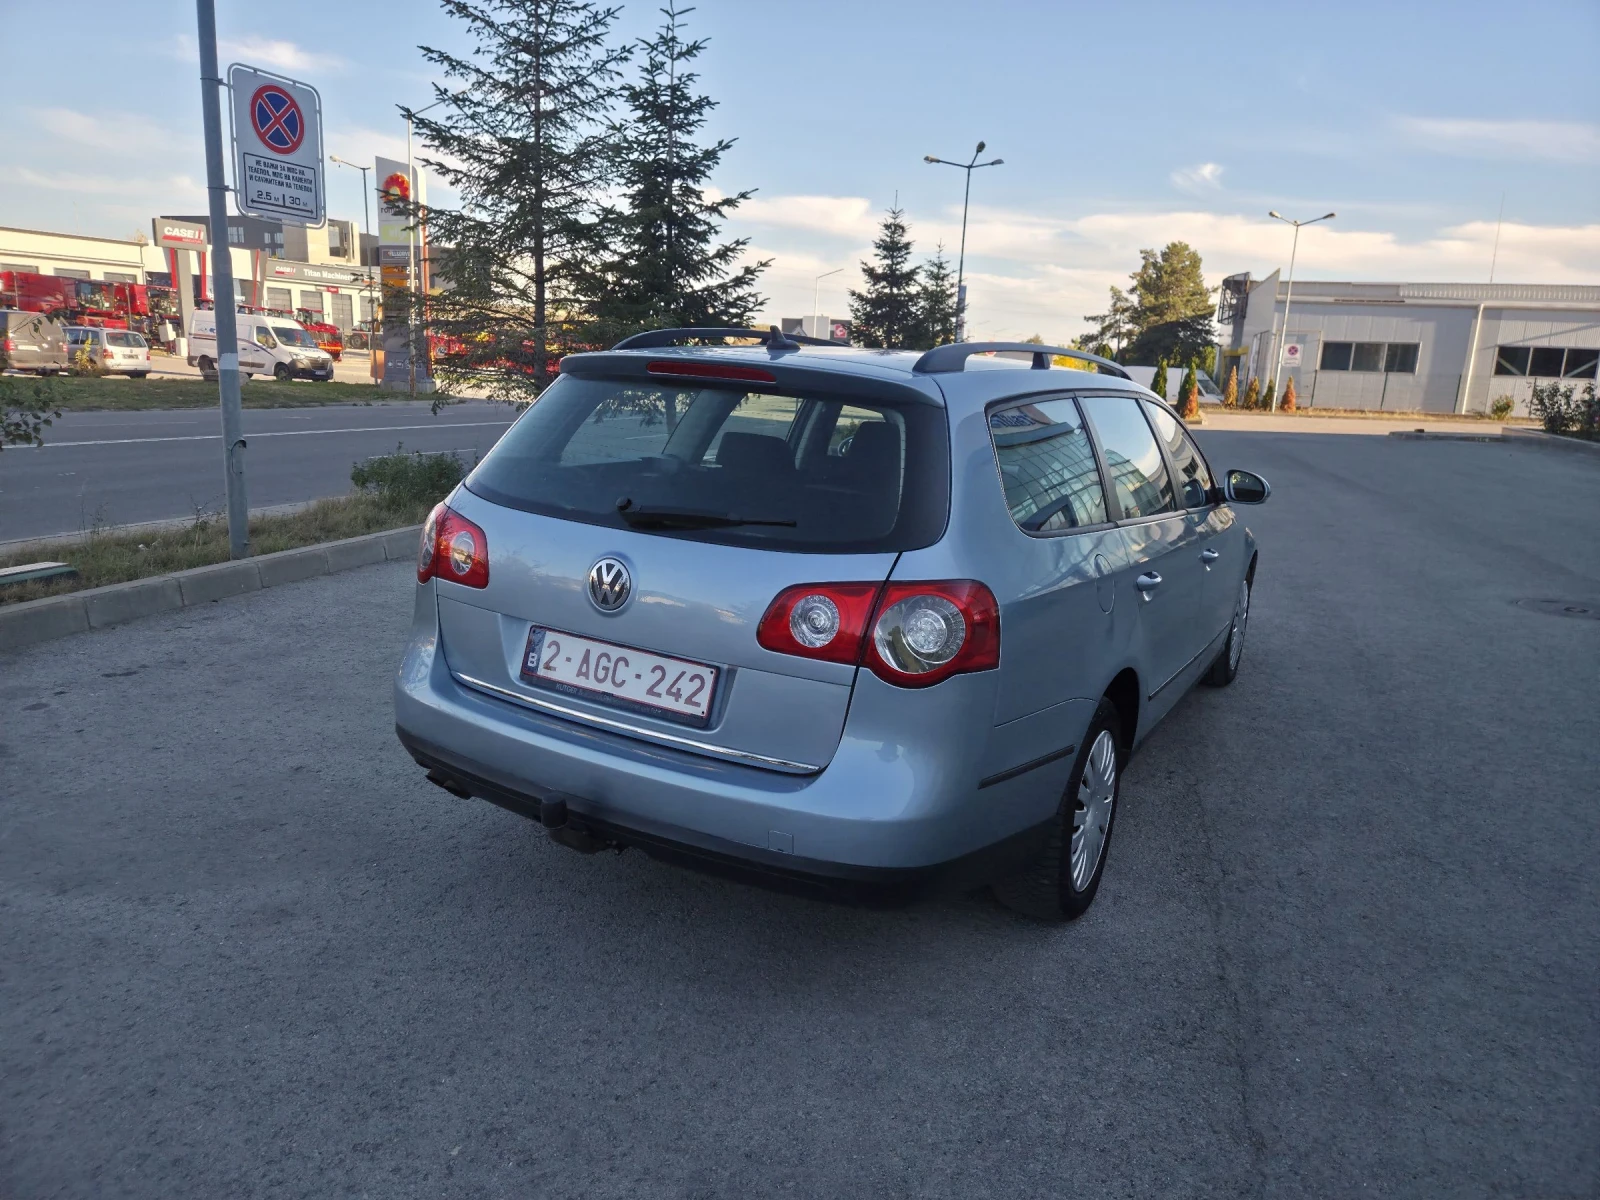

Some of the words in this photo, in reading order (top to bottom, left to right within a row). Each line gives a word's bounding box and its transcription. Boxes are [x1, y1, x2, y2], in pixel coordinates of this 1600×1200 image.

[279, 164, 286, 172] ЗА
[256, 190, 272, 201] 2.5
[288, 195, 301, 206] 30
[164, 226, 195, 239] CASE
[303, 268, 321, 277] Titan
[527, 652, 537, 667] B
[543, 640, 706, 708] 2-AGC-242
